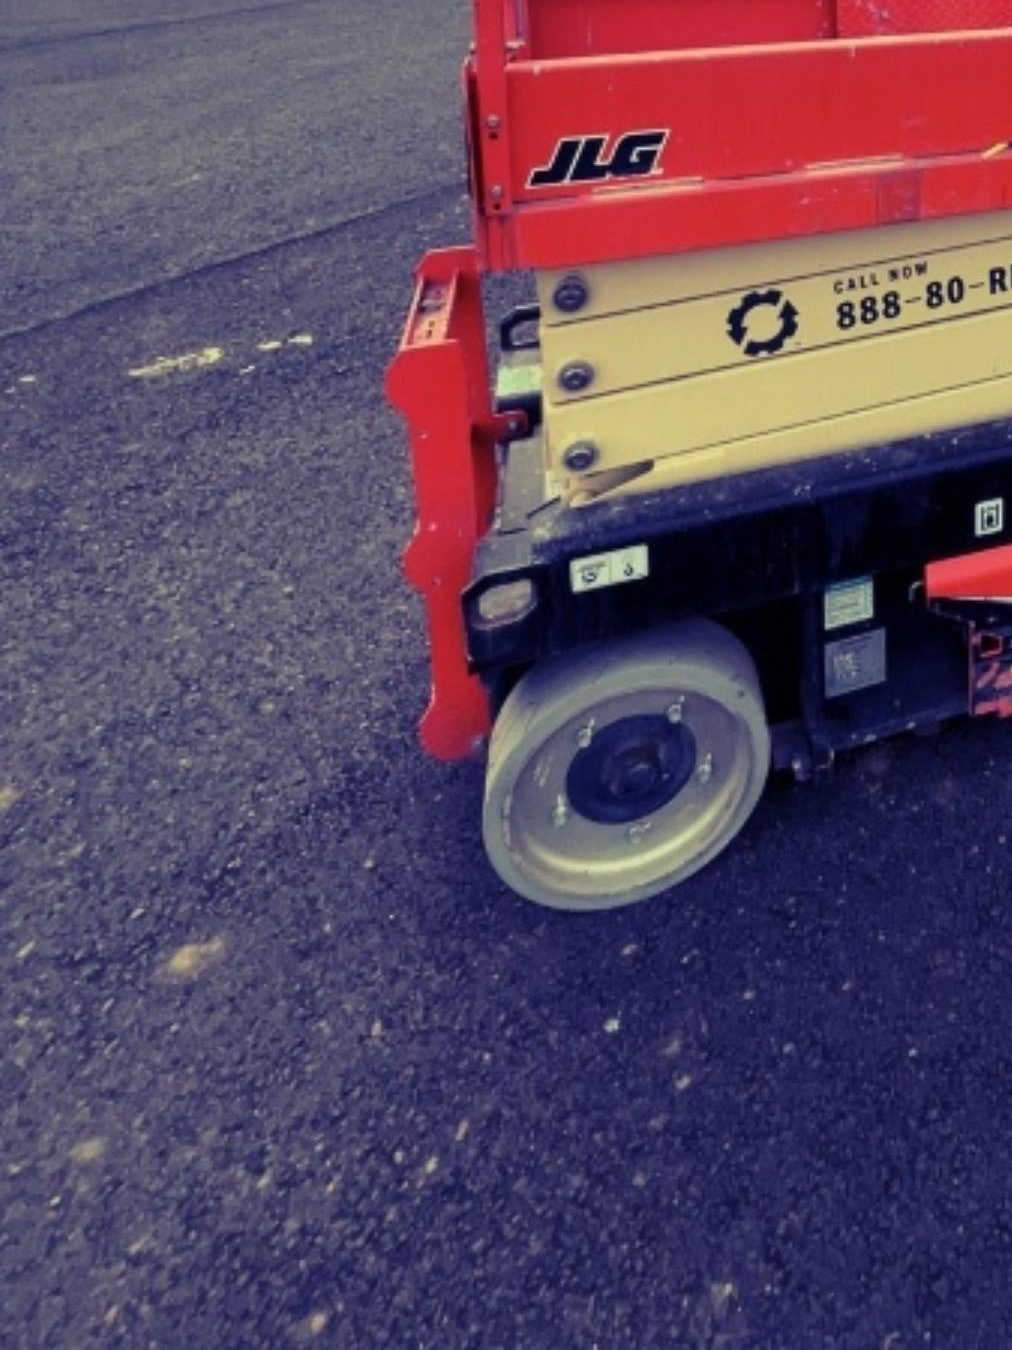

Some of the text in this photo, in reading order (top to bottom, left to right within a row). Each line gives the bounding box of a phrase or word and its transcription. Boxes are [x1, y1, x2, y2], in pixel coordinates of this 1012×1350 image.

[527, 128, 669, 189] JLG
[833, 261, 929, 295] CALL NOW
